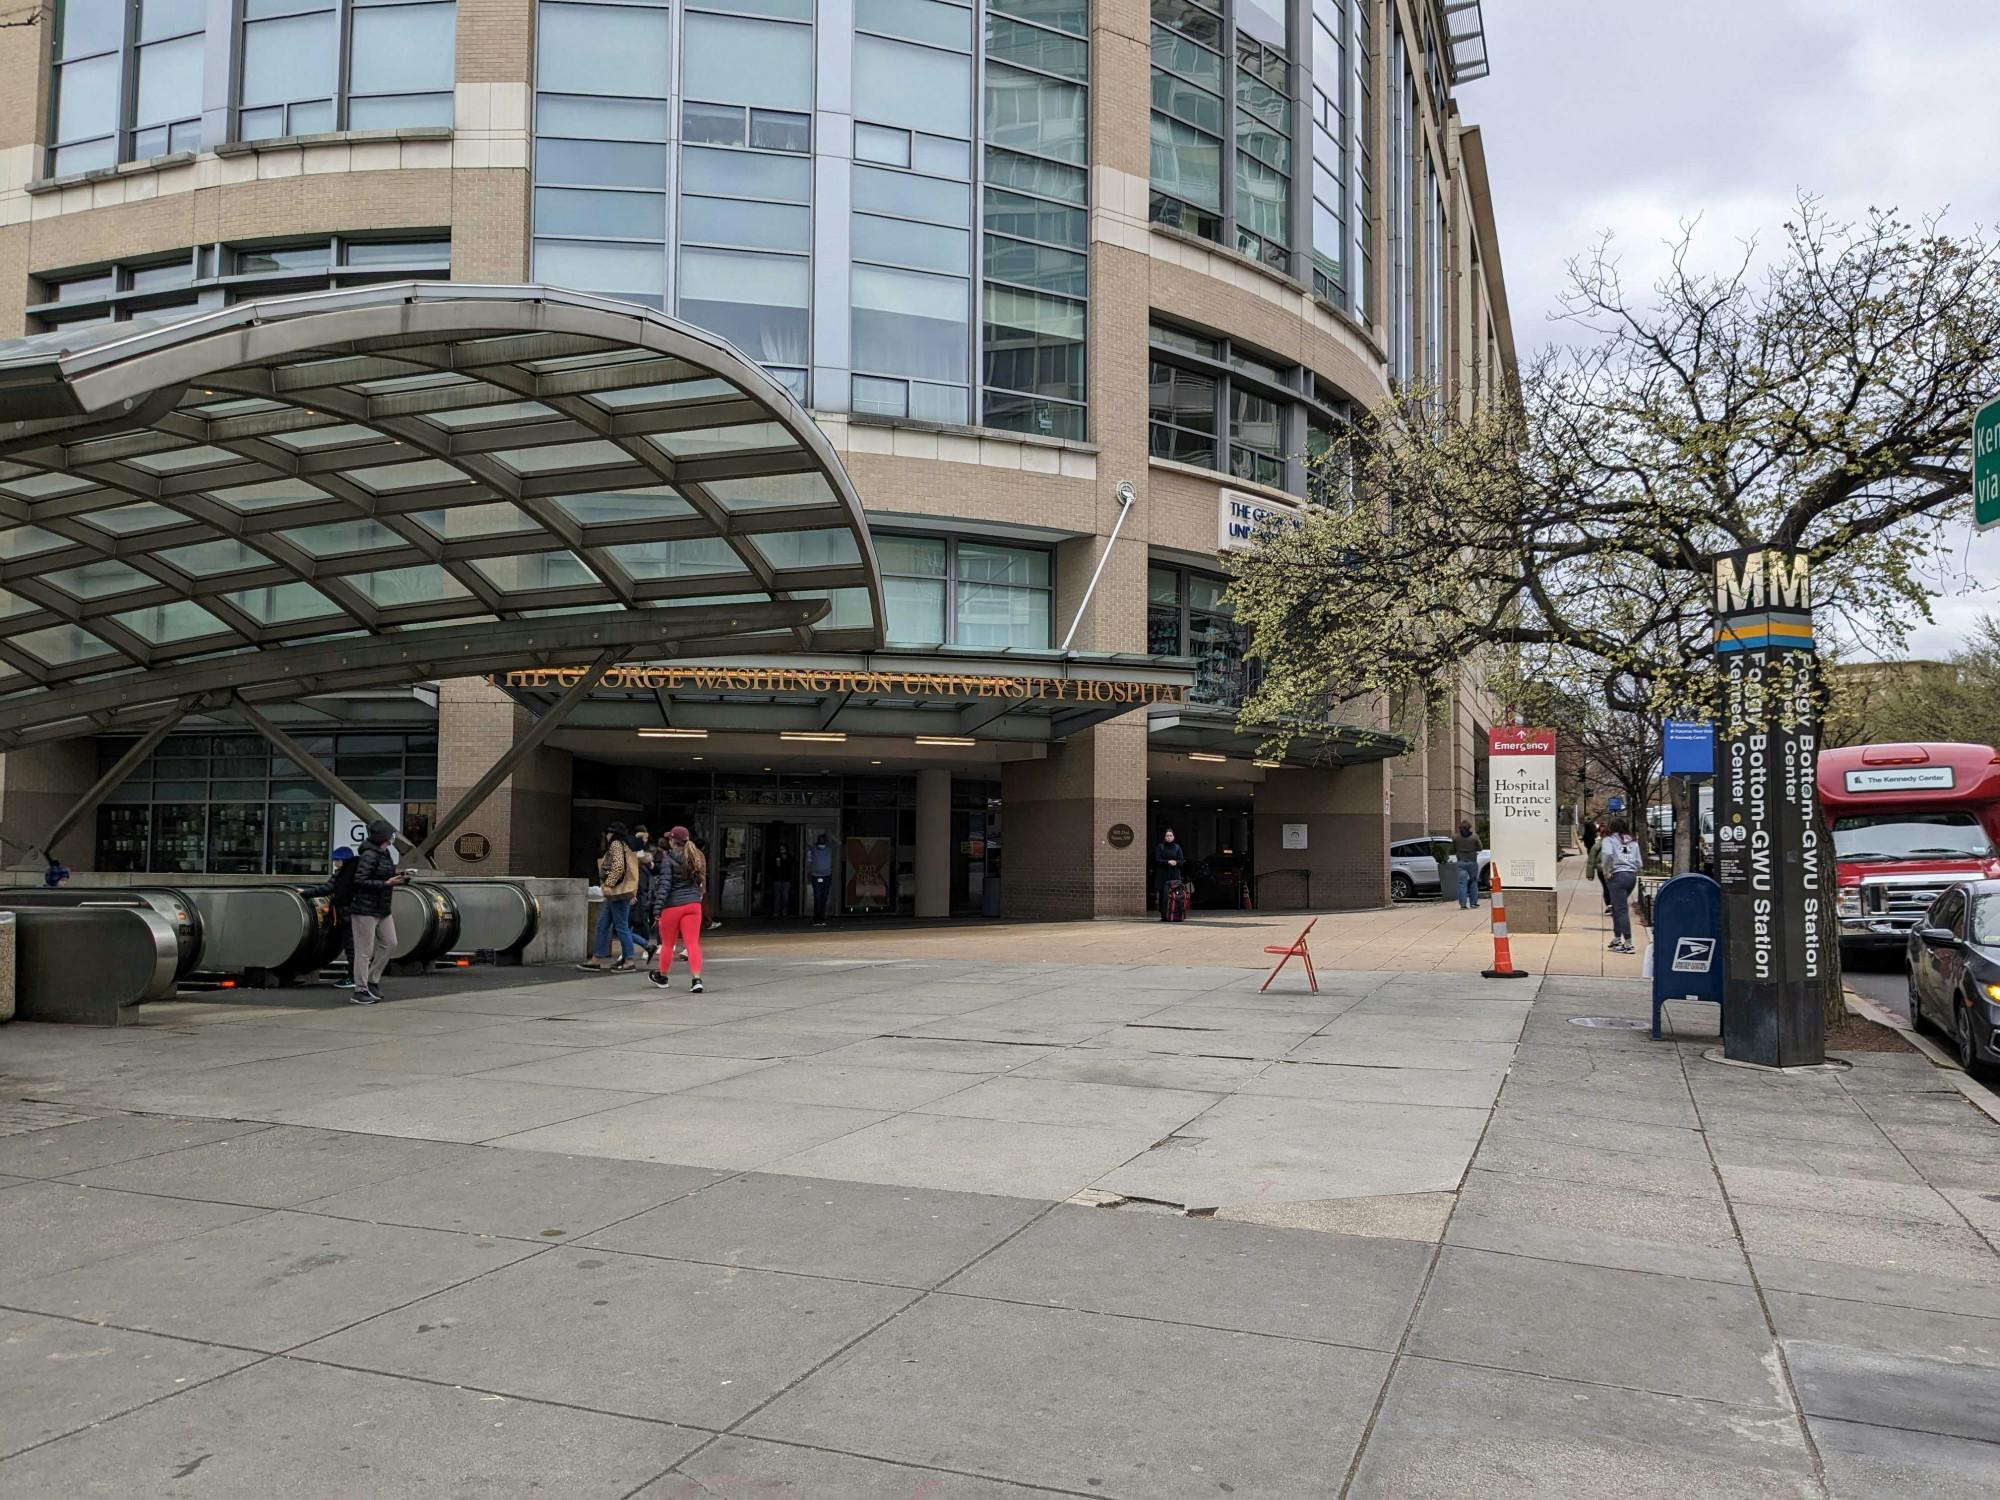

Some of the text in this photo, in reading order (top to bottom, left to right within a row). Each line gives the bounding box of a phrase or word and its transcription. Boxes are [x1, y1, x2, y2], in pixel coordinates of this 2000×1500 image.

[1229, 501, 1252, 520] THE
[1977, 468, 1999, 505] via
[1716, 551, 1809, 613] M M
[557, 666, 684, 689] GORGE
[691, 667, 893, 693] WASHINGTON
[902, 673, 1068, 701] UNIVERSITY
[1076, 679, 1191, 705] HOSPITAL
[1495, 742, 1549, 752] Emergency
[1729, 654, 1746, 805] Kenned Center
[1495, 779, 1551, 794] Hospital
[1785, 741, 1798, 804] Center
[1494, 793, 1552, 805] Entrance
[1504, 805, 1542, 818] Drive
[1748, 734, 1771, 890] Bottom-GWU
[1798, 734, 1818, 890] Bottom-GWU
[1751, 898, 1771, 978] Station
[1803, 898, 1819, 978] Station
